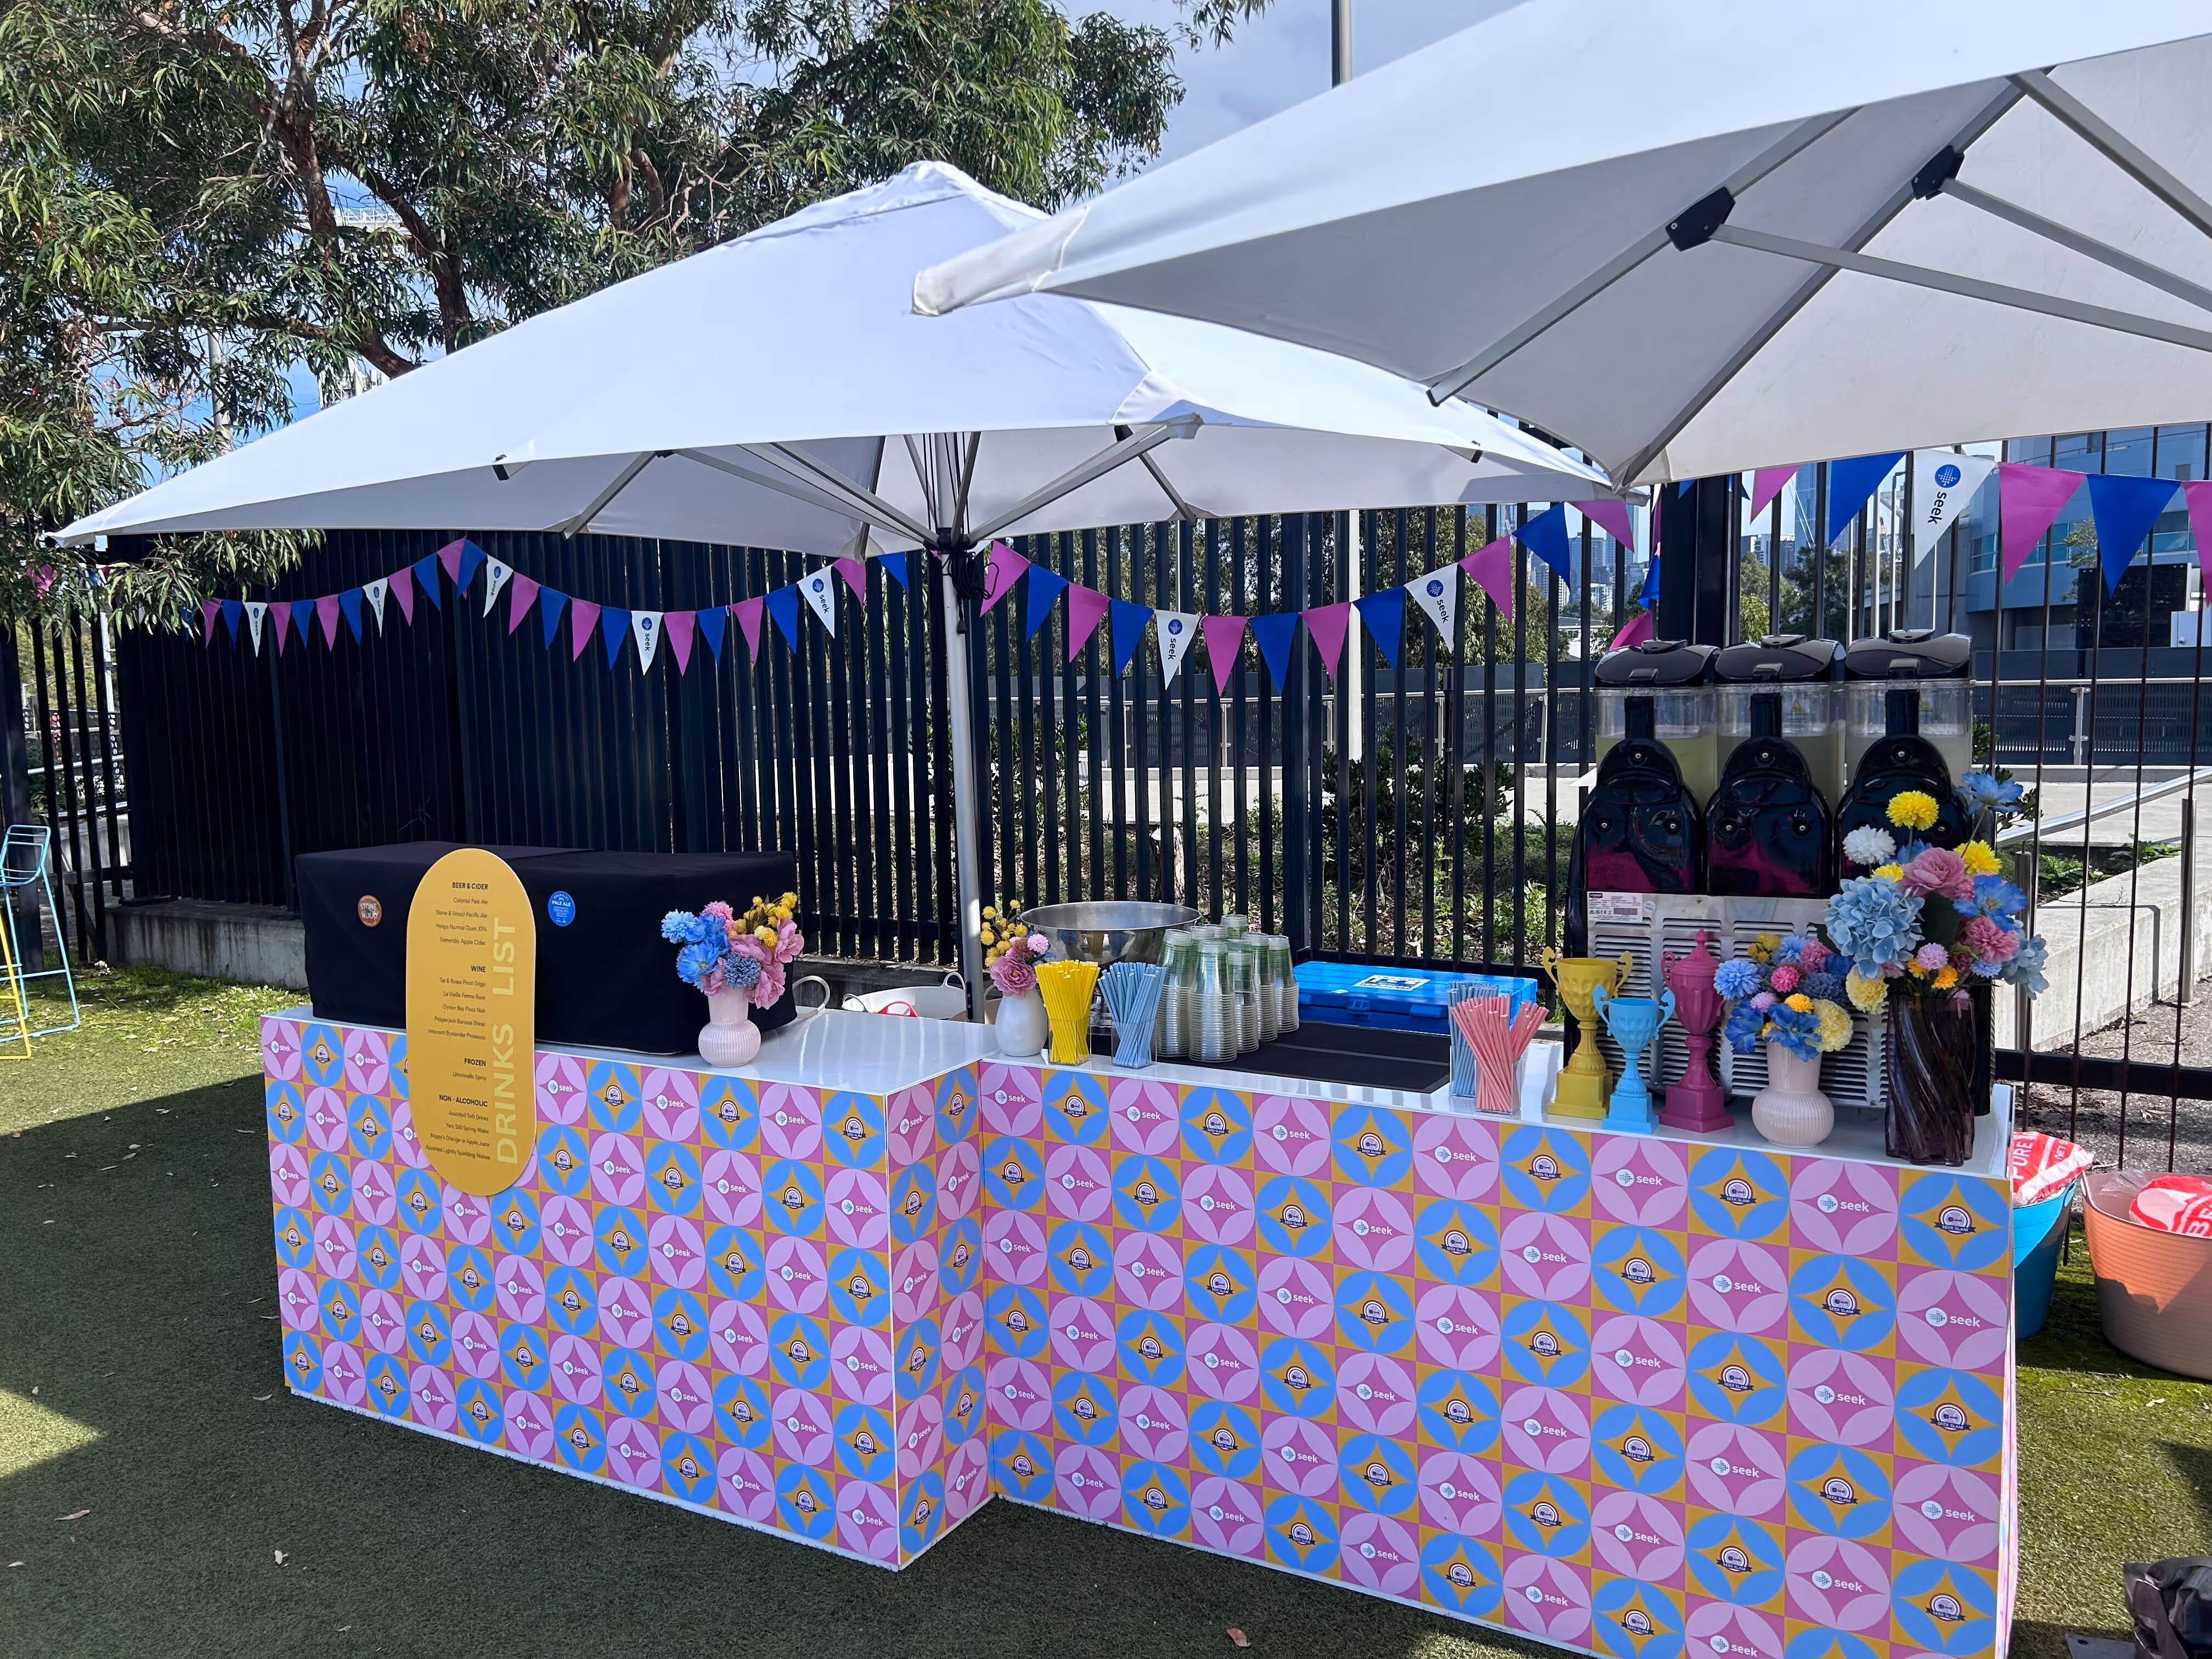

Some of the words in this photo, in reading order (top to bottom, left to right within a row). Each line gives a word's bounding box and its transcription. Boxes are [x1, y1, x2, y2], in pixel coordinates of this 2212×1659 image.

[1927, 491, 1947, 524] seek
[820, 594, 830, 614] seek
[1436, 599, 1449, 623] seek
[1167, 637, 1177, 661] seek
[493, 917, 516, 996] LIST
[464, 1058, 486, 1066] FROZEN
[453, 1071, 474, 1080] Limoncello
[493, 1024, 518, 1164] DRINKS
[456, 1097, 488, 1107] ALCOHOLIC
[669, 1100, 685, 1108] seek
[788, 1116, 806, 1125] seek
[910, 1114, 923, 1127] seek
[1142, 1111, 1161, 1120] seek
[1289, 1131, 1310, 1140] seek
[443, 1147, 456, 1155] Lightly
[458, 1150, 475, 1159] Sparkling
[1453, 1152, 1476, 1162] seek
[2013, 1141, 2034, 1180] PURE
[615, 1166, 630, 1174] seek
[957, 1171, 969, 1184] seek
[1637, 1176, 1662, 1186] seek
[730, 1184, 747, 1193] seek
[1076, 1180, 1094, 1188] seek
[373, 1189, 386, 1198] seek
[855, 1205, 873, 1214] seek
[1216, 1201, 1236, 1211] seek
[1840, 1201, 1869, 1212] seek
[565, 1228, 580, 1236] seek
[1370, 1226, 1393, 1235] seek
[675, 1249, 691, 1257] seek
[1013, 1244, 1031, 1252] seek
[1543, 1253, 1567, 1263] seek
[422, 1265, 435, 1273] seek
[1146, 1268, 1165, 1277] seek
[794, 1272, 811, 1281] seek
[914, 1272, 927, 1285] seek
[518, 1286, 532, 1294] seek
[1734, 1282, 1761, 1293] seek
[1293, 1294, 1313, 1304] seek
[623, 1310, 638, 1318] seek
[1950, 1316, 1980, 1328] seek
[961, 1322, 973, 1334] seek
[1455, 1324, 1478, 1335] seek
[737, 1334, 753, 1344] seek
[1080, 1331, 1098, 1340] seek
[1220, 1359, 1240, 1369] seek
[1635, 1355, 1661, 1368] seek
[574, 1367, 589, 1375] seek
[860, 1362, 878, 1372] seek
[683, 1393, 698, 1402] seek
[1018, 1391, 1035, 1400] seek
[1374, 1391, 1395, 1401] seek
[1837, 1393, 1866, 1406] seek
[527, 1421, 540, 1430] seek
[800, 1424, 817, 1432] seek
[1151, 1420, 1170, 1430] seek
[918, 1426, 932, 1440] seek
[1543, 1426, 1567, 1438] seek
[631, 1450, 646, 1458] seek
[1297, 1453, 1317, 1463] seek
[1732, 1466, 1759, 1478] seek
[744, 1481, 760, 1490] seek
[1457, 1490, 1480, 1502] seek
[1225, 1513, 1244, 1522] seek
[1945, 1509, 1975, 1522] seek
[866, 1516, 883, 1526] seek
[1635, 1533, 1660, 1545] seek
[1377, 1550, 1398, 1561] seek
[1834, 1579, 1863, 1592] seek
[1544, 1594, 1568, 1607] seek
[1731, 1644, 1758, 1657] seek
